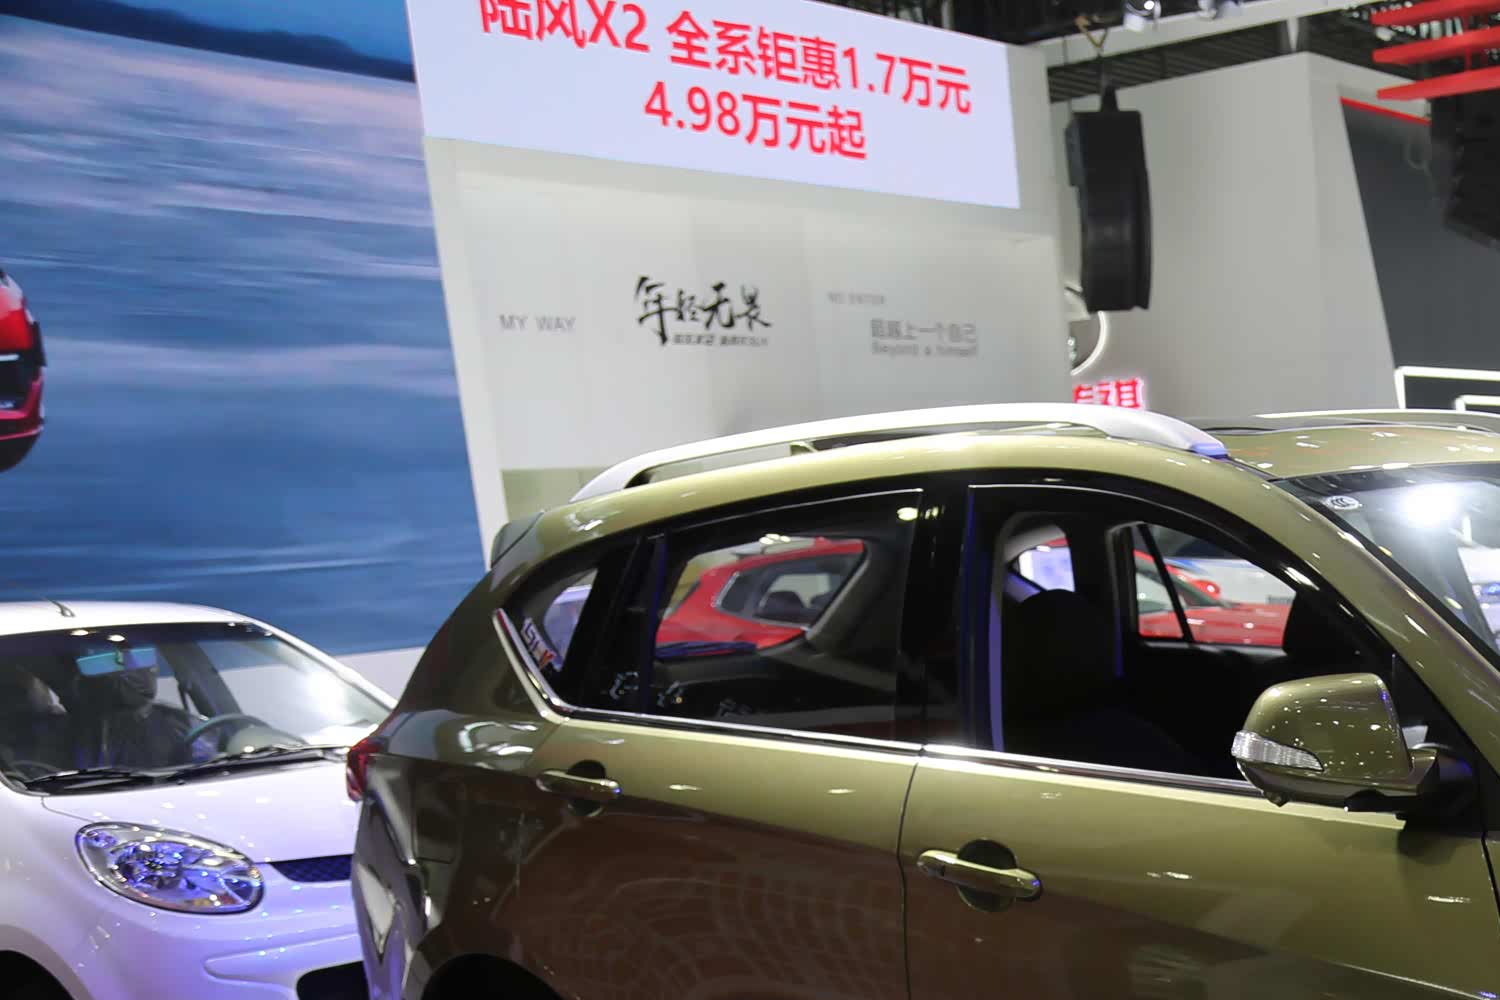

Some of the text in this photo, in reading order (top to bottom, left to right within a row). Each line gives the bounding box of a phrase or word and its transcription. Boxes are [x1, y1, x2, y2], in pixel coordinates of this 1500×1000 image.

[481, 0, 972, 114] 陆风X2 全系钜惠1.7万元
[643, 81, 867, 160] 4.98万元起
[499, 315, 576, 332] MY WAY
